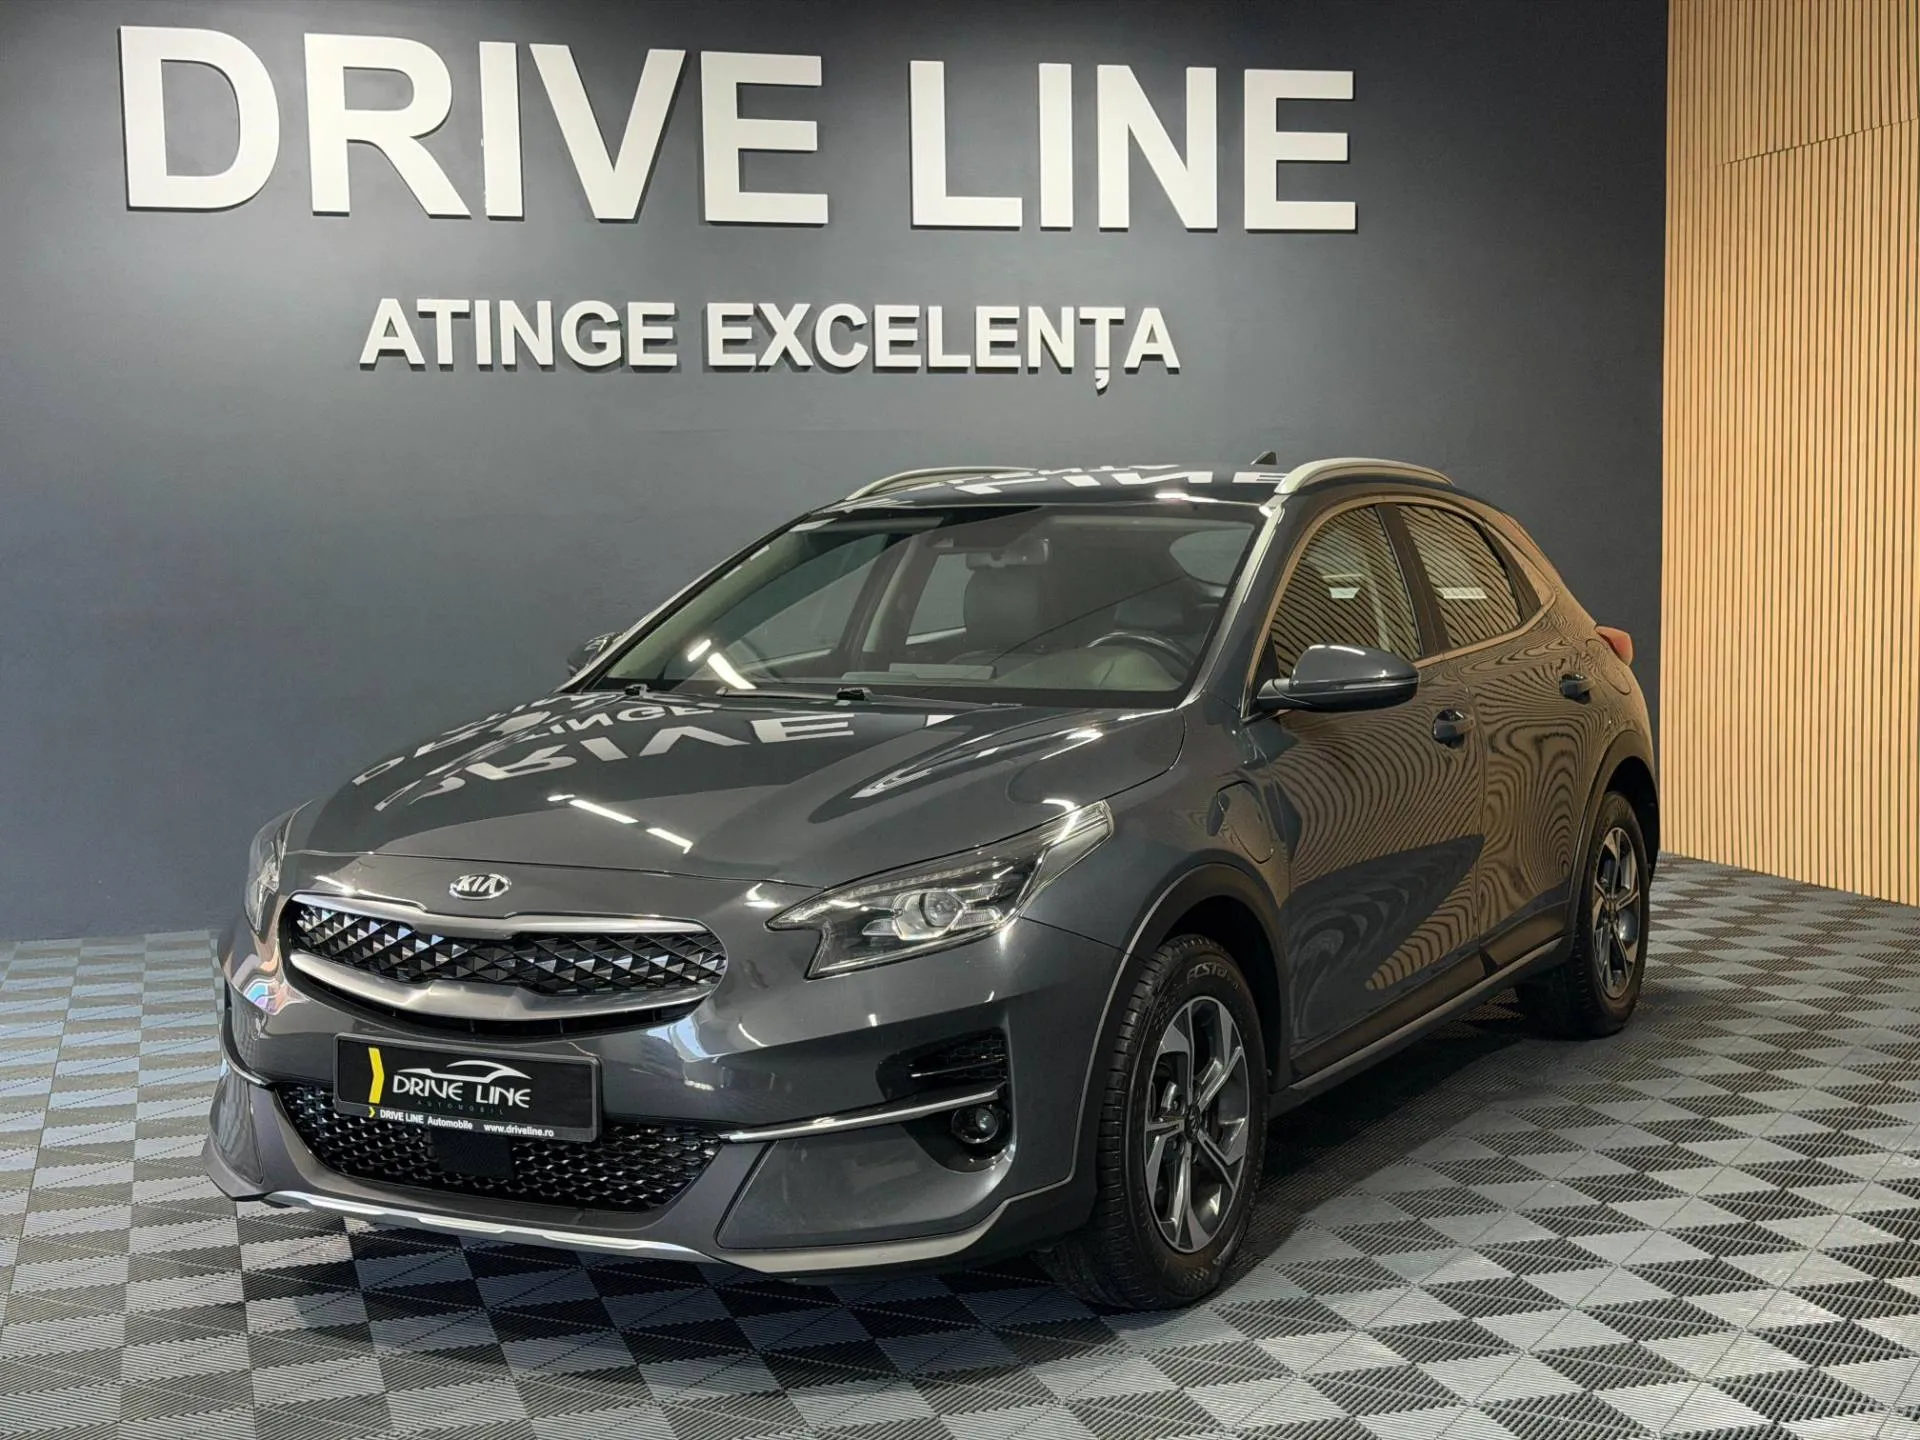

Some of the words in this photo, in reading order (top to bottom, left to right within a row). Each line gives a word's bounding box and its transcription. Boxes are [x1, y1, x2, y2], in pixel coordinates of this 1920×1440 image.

[119, 25, 829, 225] DRIVE
[910, 60, 1357, 231] LINE
[359, 298, 678, 368] ATINGE
[456, 875, 499, 894] KIA
[392, 1075, 463, 1102] DRIVE
[475, 1085, 532, 1109] LINE
[379, 1109, 404, 1121] DRIVE
[405, 1112, 424, 1124] LINE
[427, 1115, 473, 1130] Automobile
[483, 1123, 555, 1137] www.driveline.ro
